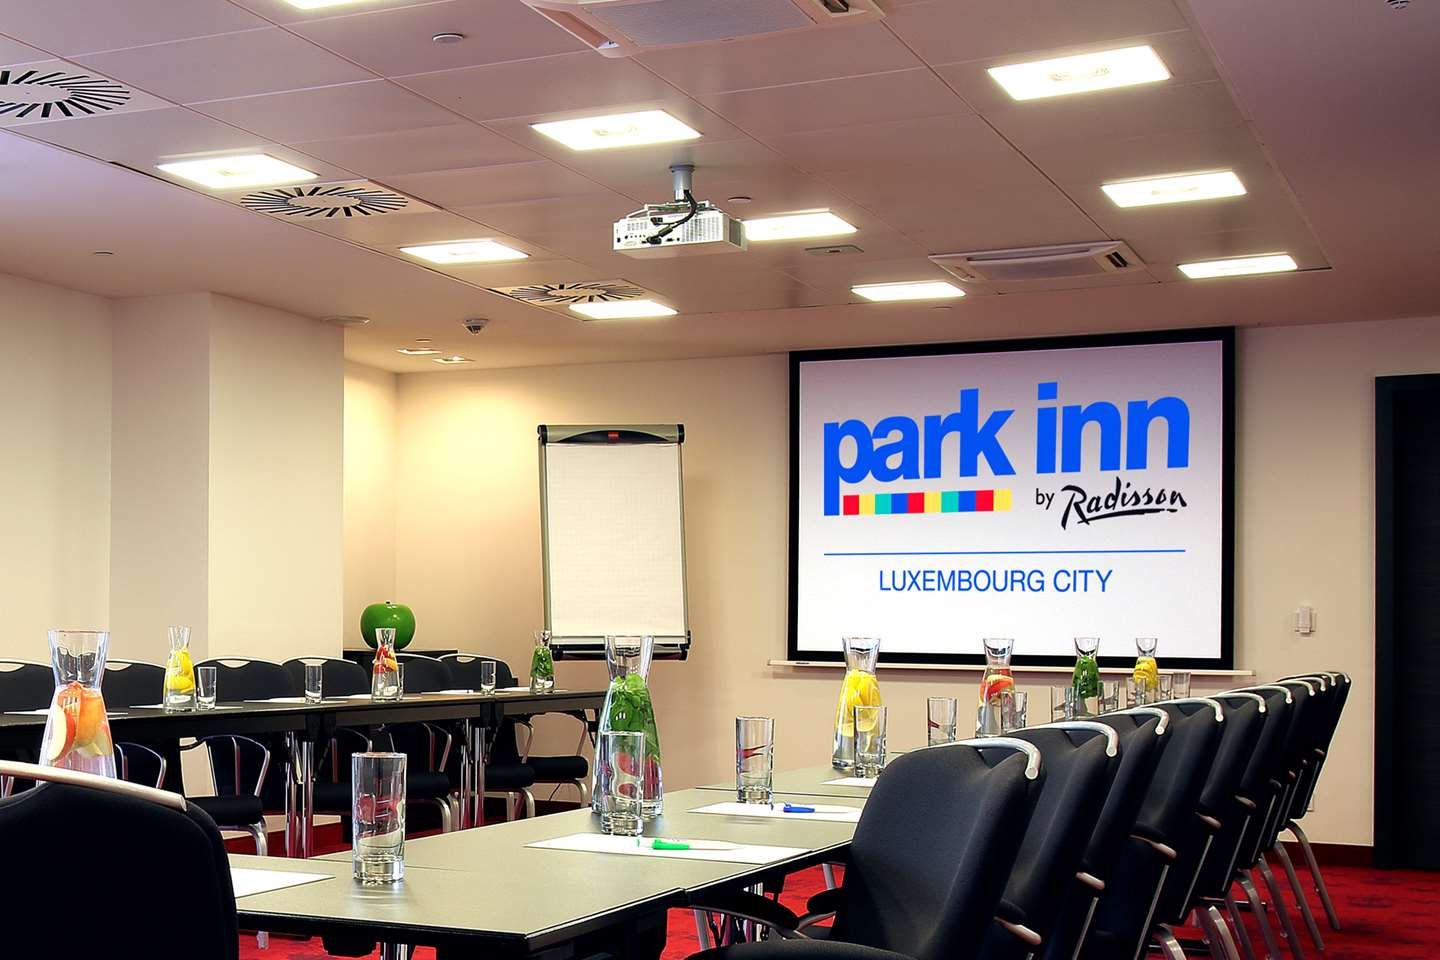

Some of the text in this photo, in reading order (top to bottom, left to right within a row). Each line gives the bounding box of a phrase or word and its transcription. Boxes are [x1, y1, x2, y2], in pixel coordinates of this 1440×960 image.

[823, 381, 1190, 516] park inn
[1035, 477, 1188, 530] by Radisson
[879, 569, 1113, 593] LUXEMBOURG CITY
